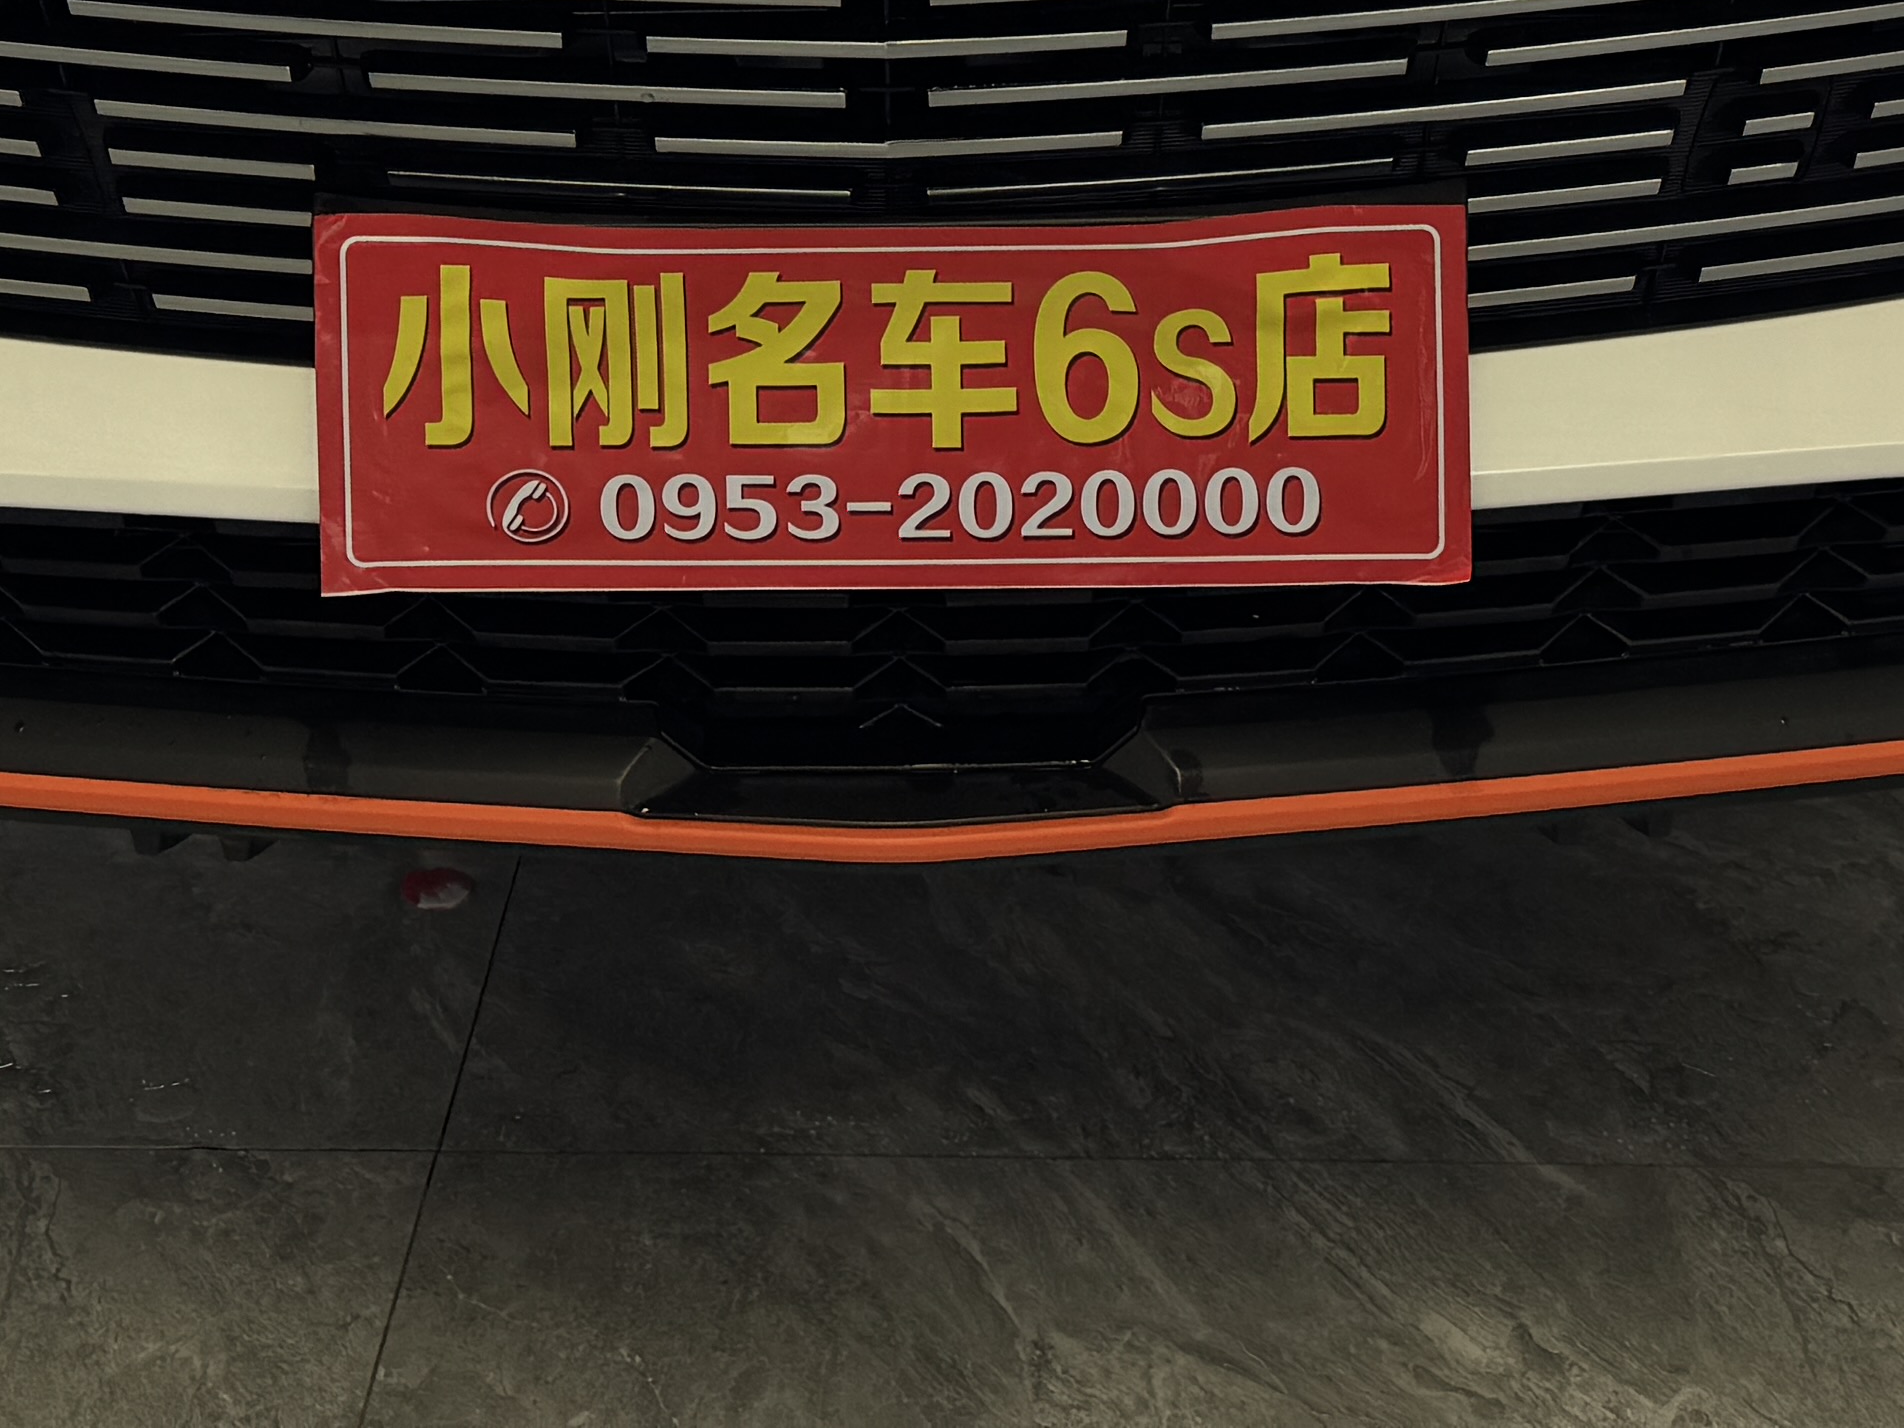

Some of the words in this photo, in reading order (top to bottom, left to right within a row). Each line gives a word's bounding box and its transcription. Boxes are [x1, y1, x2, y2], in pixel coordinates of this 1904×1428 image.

[382, 251, 1393, 450] 小刚名车6s店
[599, 465, 1322, 542] 0953-2020000
